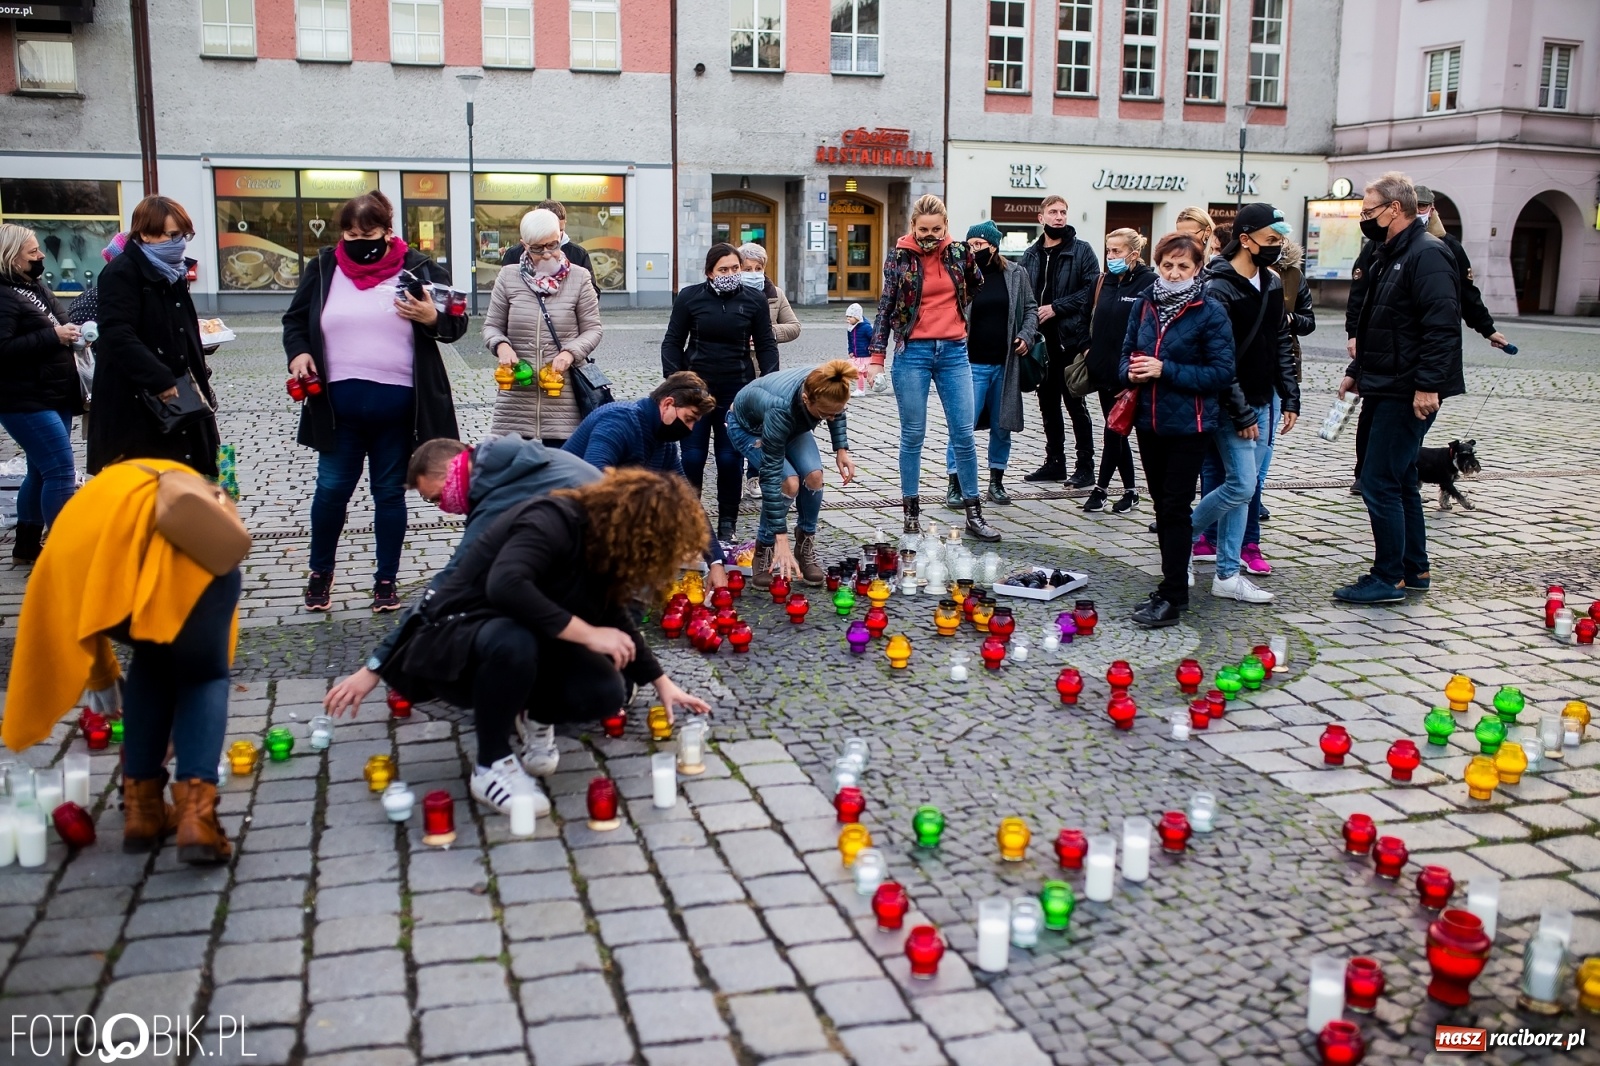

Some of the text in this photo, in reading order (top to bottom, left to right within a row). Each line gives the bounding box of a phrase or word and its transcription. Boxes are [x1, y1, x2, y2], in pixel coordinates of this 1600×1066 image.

[816, 146, 933, 167] RESTAURACJA
[236, 175, 281, 189] Ciasta
[1093, 168, 1188, 192] JUBILER
[1209, 208, 1238, 218] ZEGAR
